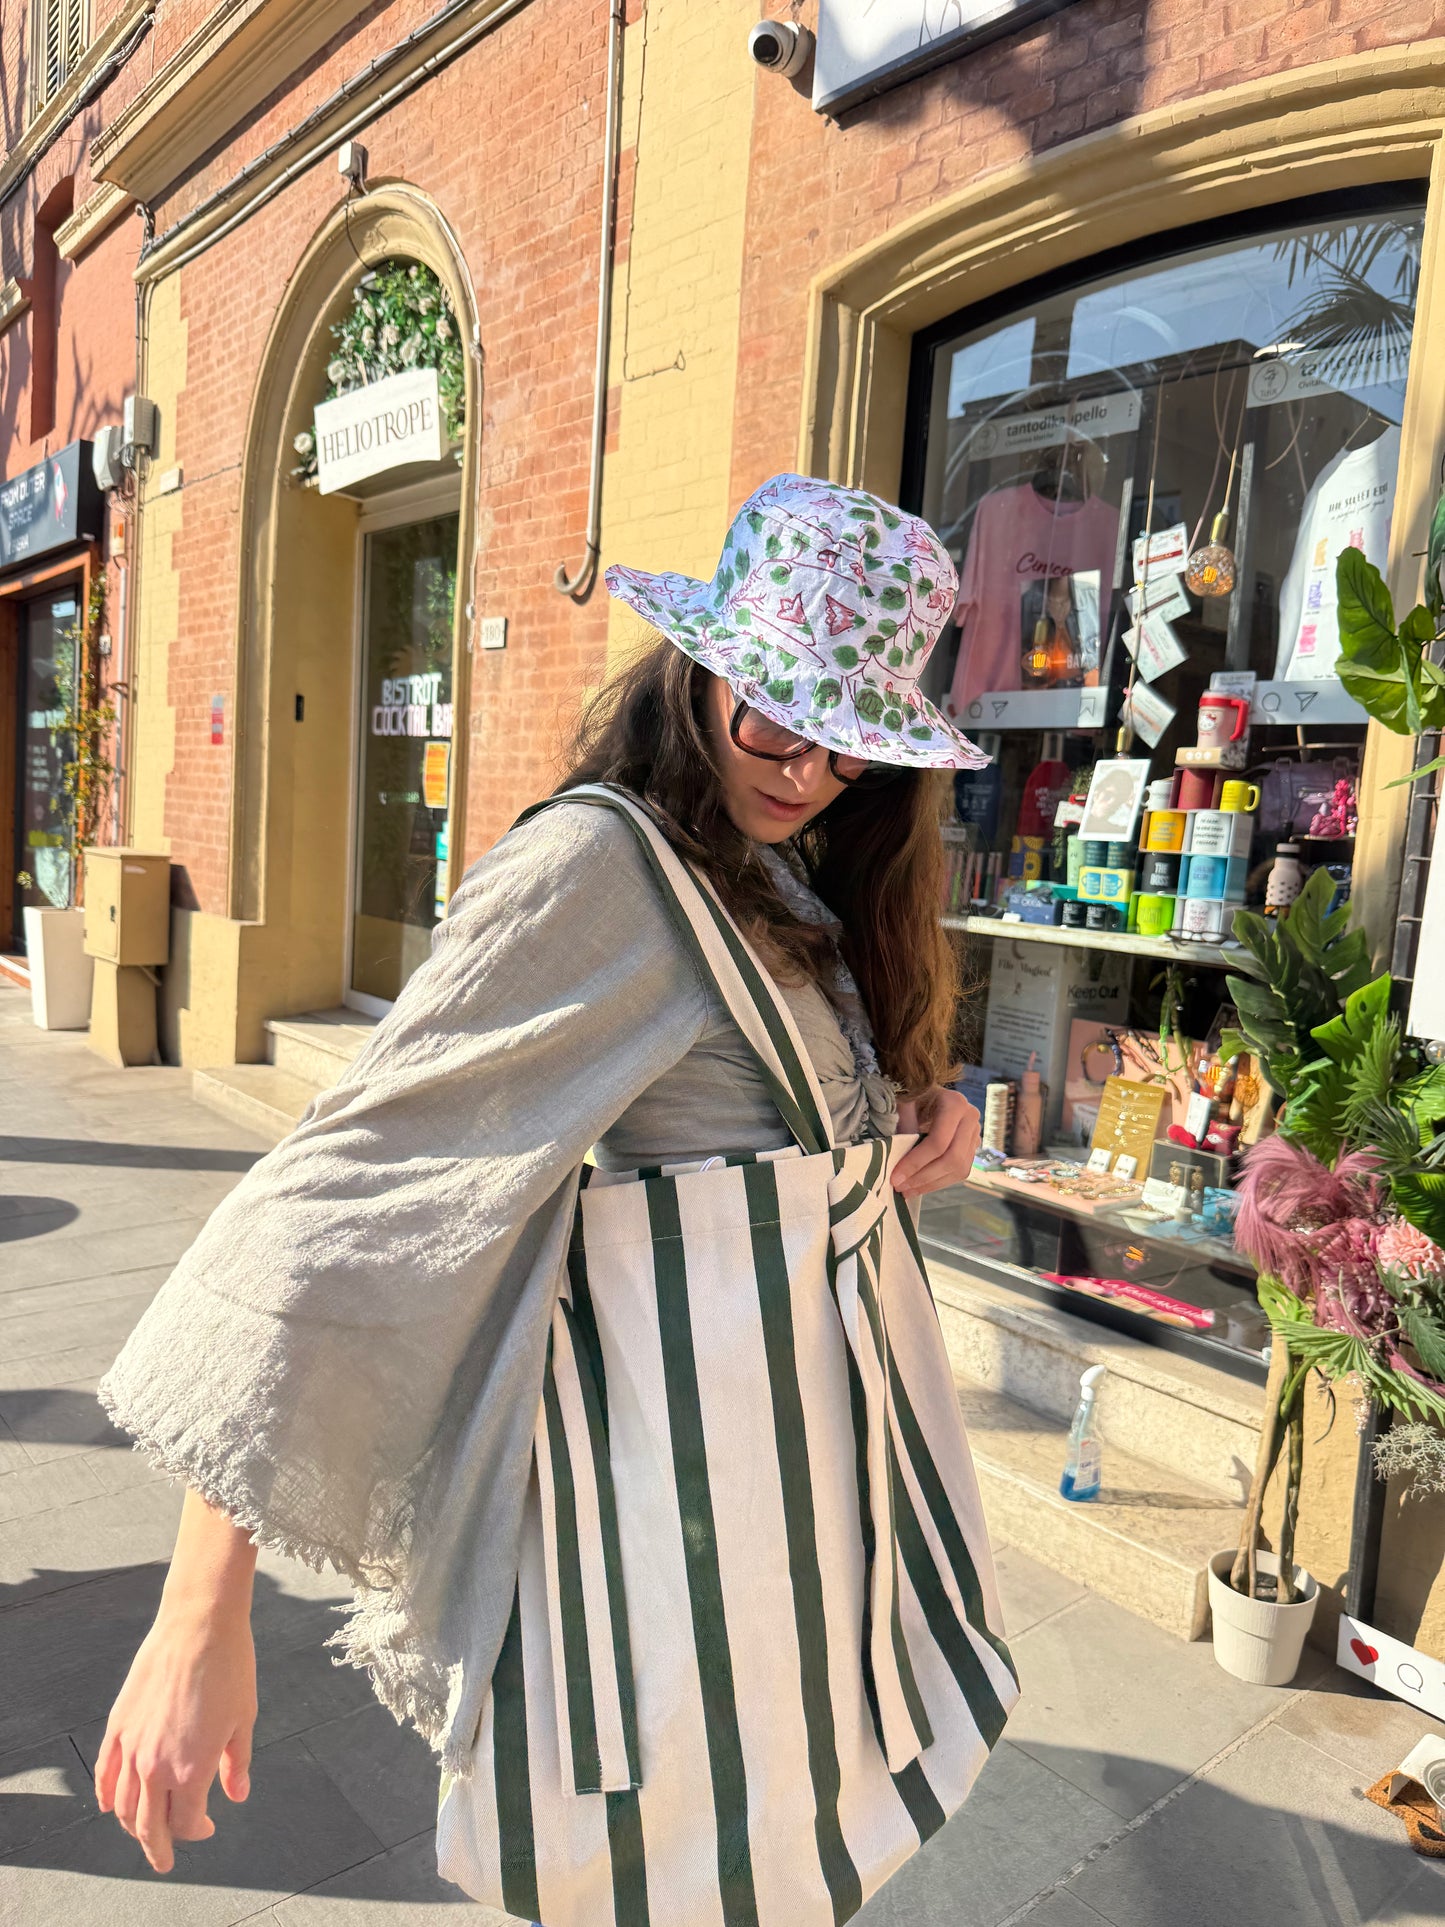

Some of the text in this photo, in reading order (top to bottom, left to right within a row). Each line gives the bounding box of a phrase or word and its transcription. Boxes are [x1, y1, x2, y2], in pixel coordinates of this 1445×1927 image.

[322, 397, 434, 464] HELIOTROPE
[382, 672, 442, 706] BISTROT
[372, 703, 431, 737] COCKTAIL
[1067, 983, 1119, 1001] Keep Out
